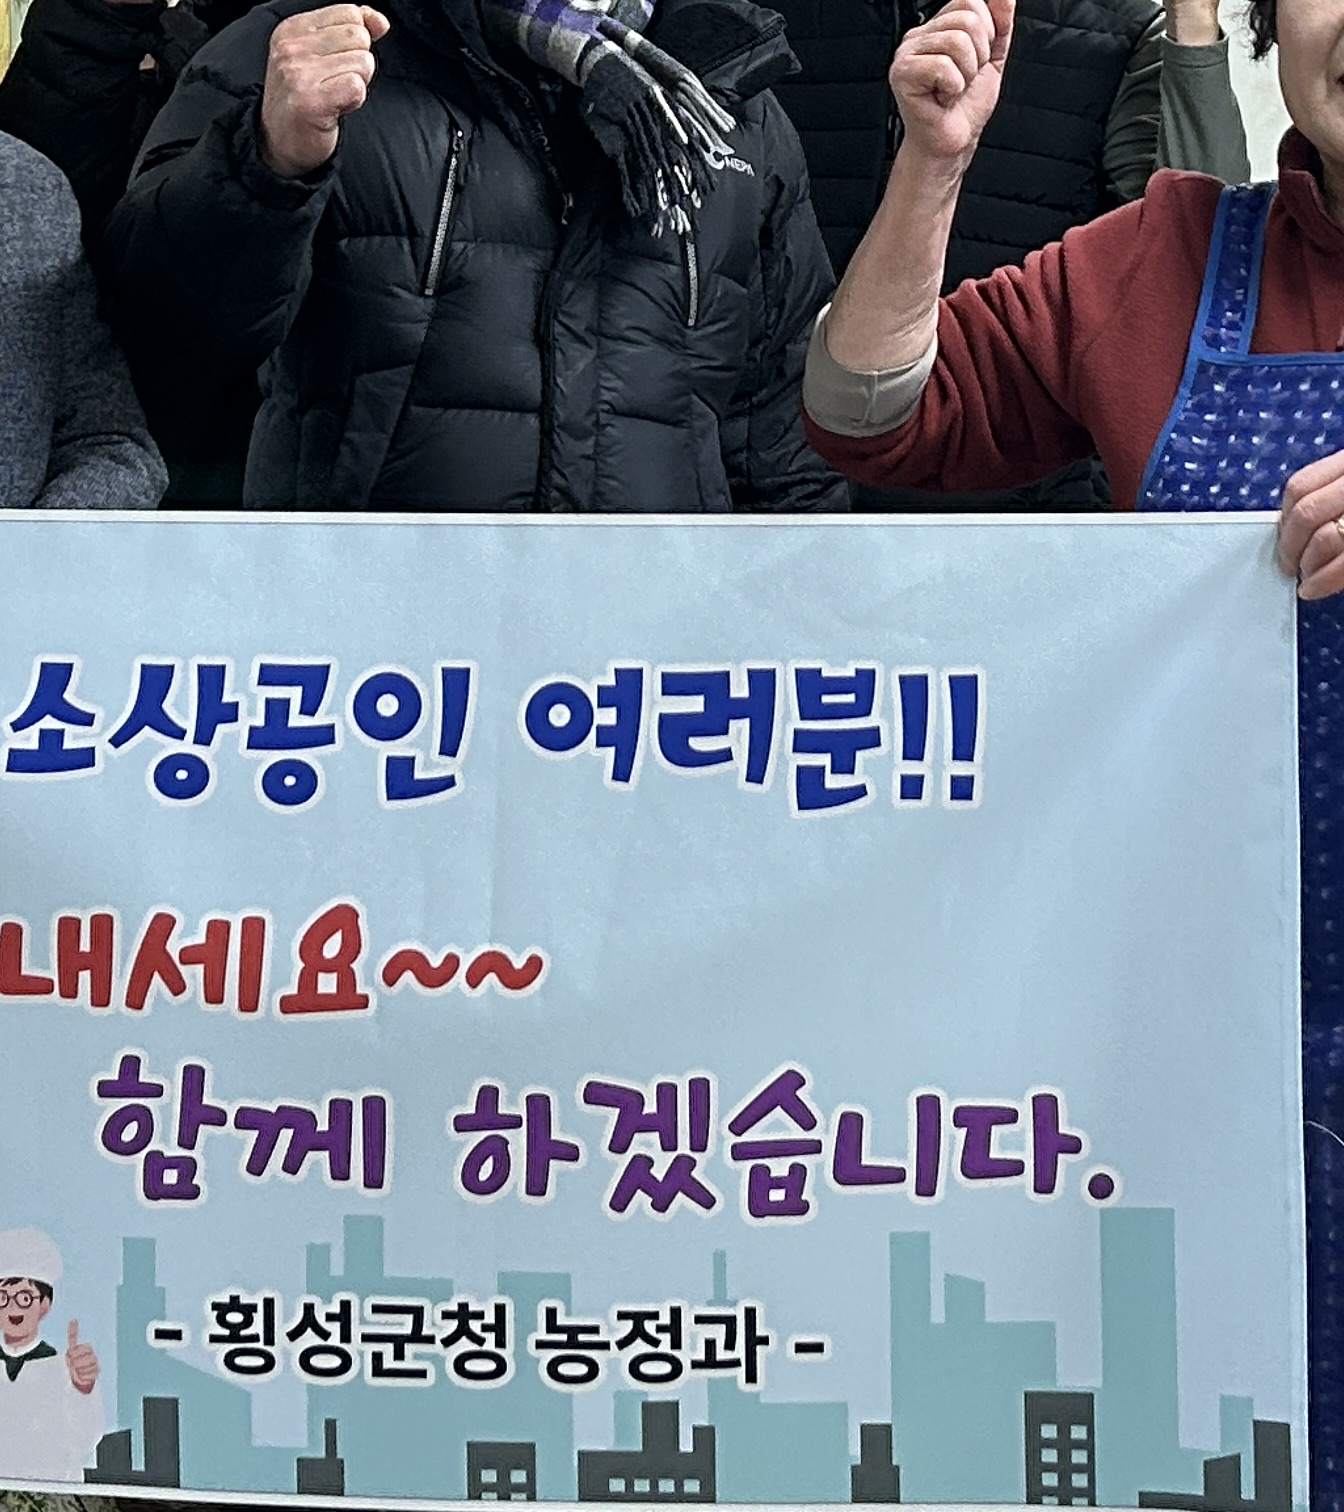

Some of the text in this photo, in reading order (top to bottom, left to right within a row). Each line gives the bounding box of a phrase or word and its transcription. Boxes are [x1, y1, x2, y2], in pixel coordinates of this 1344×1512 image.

[3, 661, 981, 811] 소상공인 여러분!!
[96, 1053, 1118, 1220] 함께 하겠습니다.
[208, 1294, 509, 1382] 횡성군청
[535, 1304, 770, 1386] 농정과
